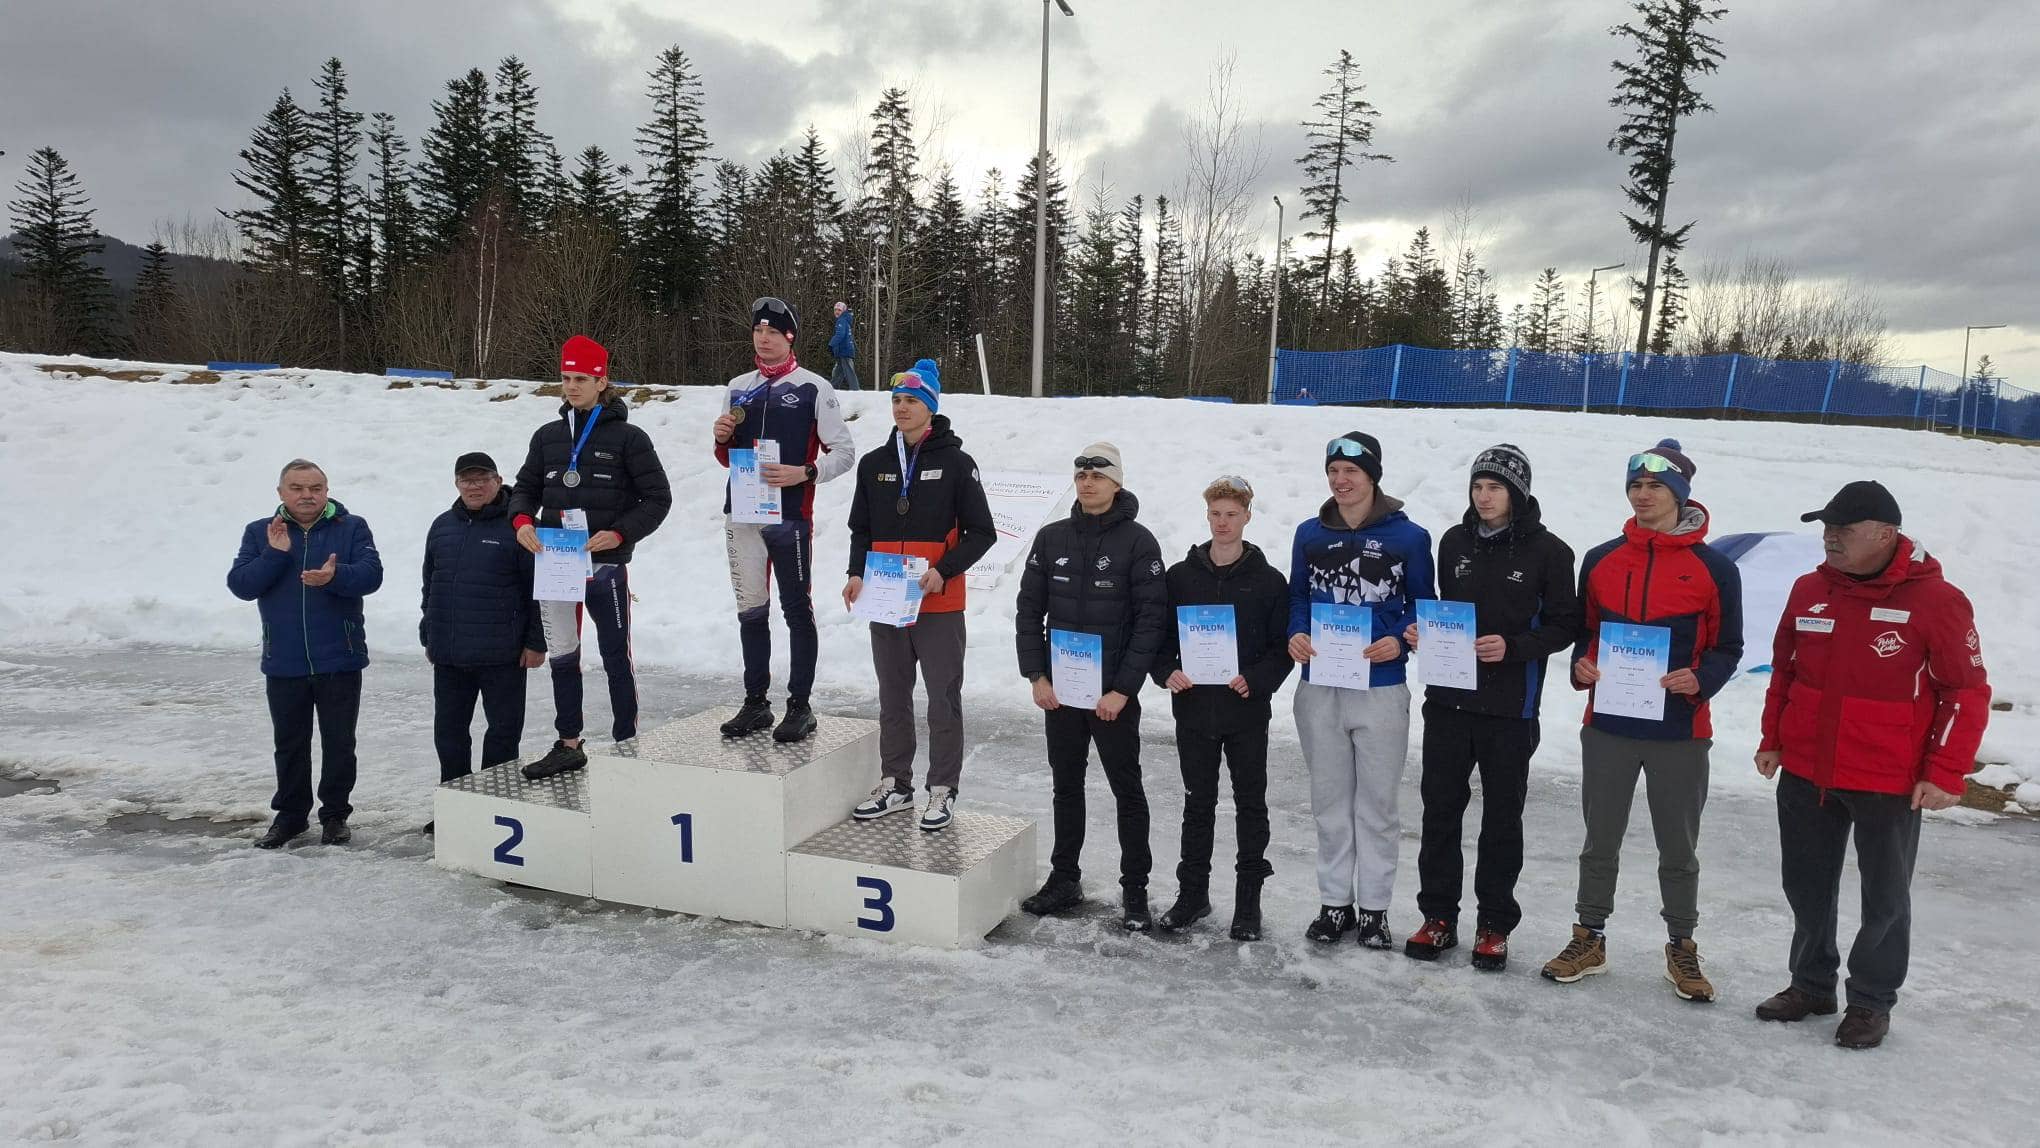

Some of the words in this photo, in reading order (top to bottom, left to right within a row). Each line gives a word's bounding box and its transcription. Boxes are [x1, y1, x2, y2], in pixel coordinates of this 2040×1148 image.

[545, 545, 578, 553] DYPLOM
[874, 570, 904, 579] DYPLOM
[1807, 603, 1829, 614] 4F
[1189, 624, 1225, 632] DYPLOM
[1322, 623, 1360, 633] DYPLOM
[1428, 620, 1464, 630] DYPLOM
[1060, 648, 1092, 659] DYPLOM
[1612, 645, 1655, 657] DYPLOM
[494, 815, 524, 867] 2
[671, 813, 693, 863] 1
[856, 876, 895, 932] 3
